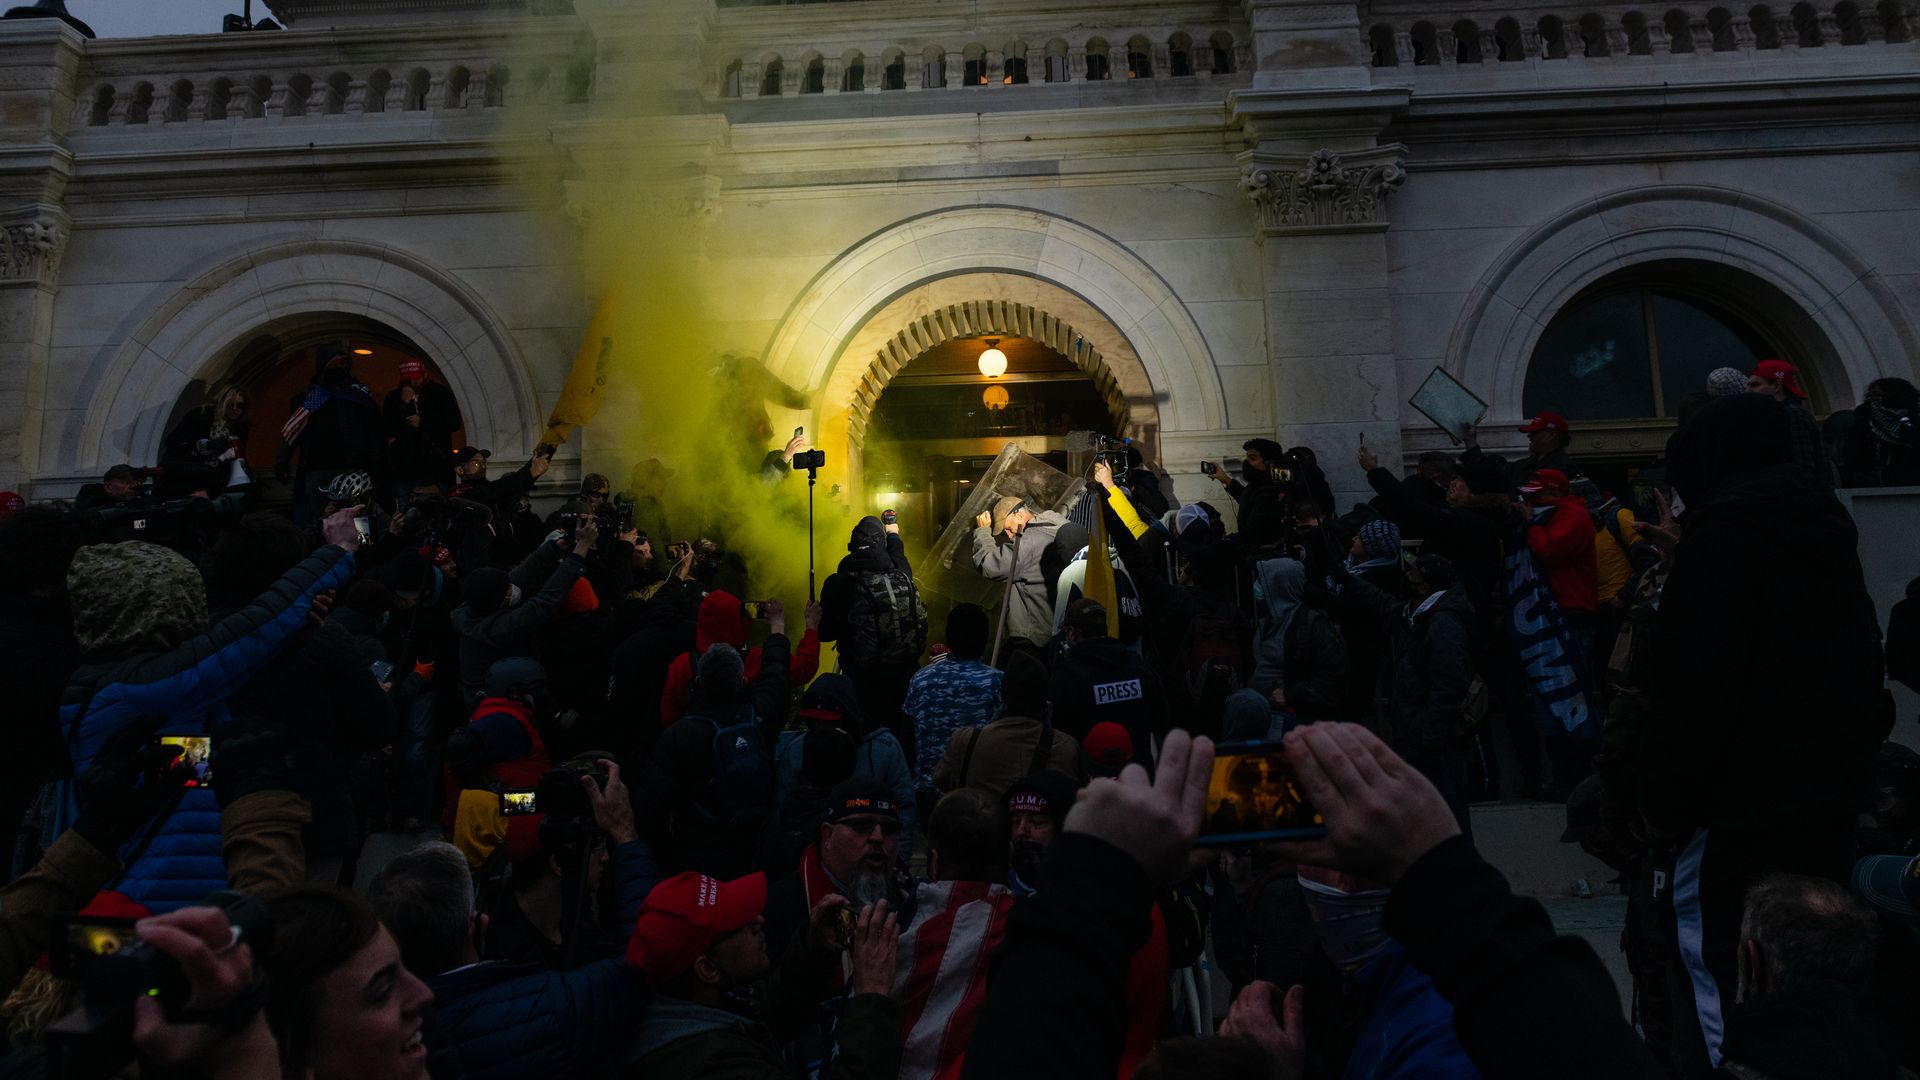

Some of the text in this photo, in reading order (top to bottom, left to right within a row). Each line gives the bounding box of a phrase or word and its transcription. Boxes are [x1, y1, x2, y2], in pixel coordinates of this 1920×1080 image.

[1505, 547, 1589, 733] RUMP
[1097, 682, 1139, 702] PRESS
[1009, 795, 1047, 806] RUMP
[698, 882, 707, 907] MAKE
[709, 881, 717, 906] GREAT
